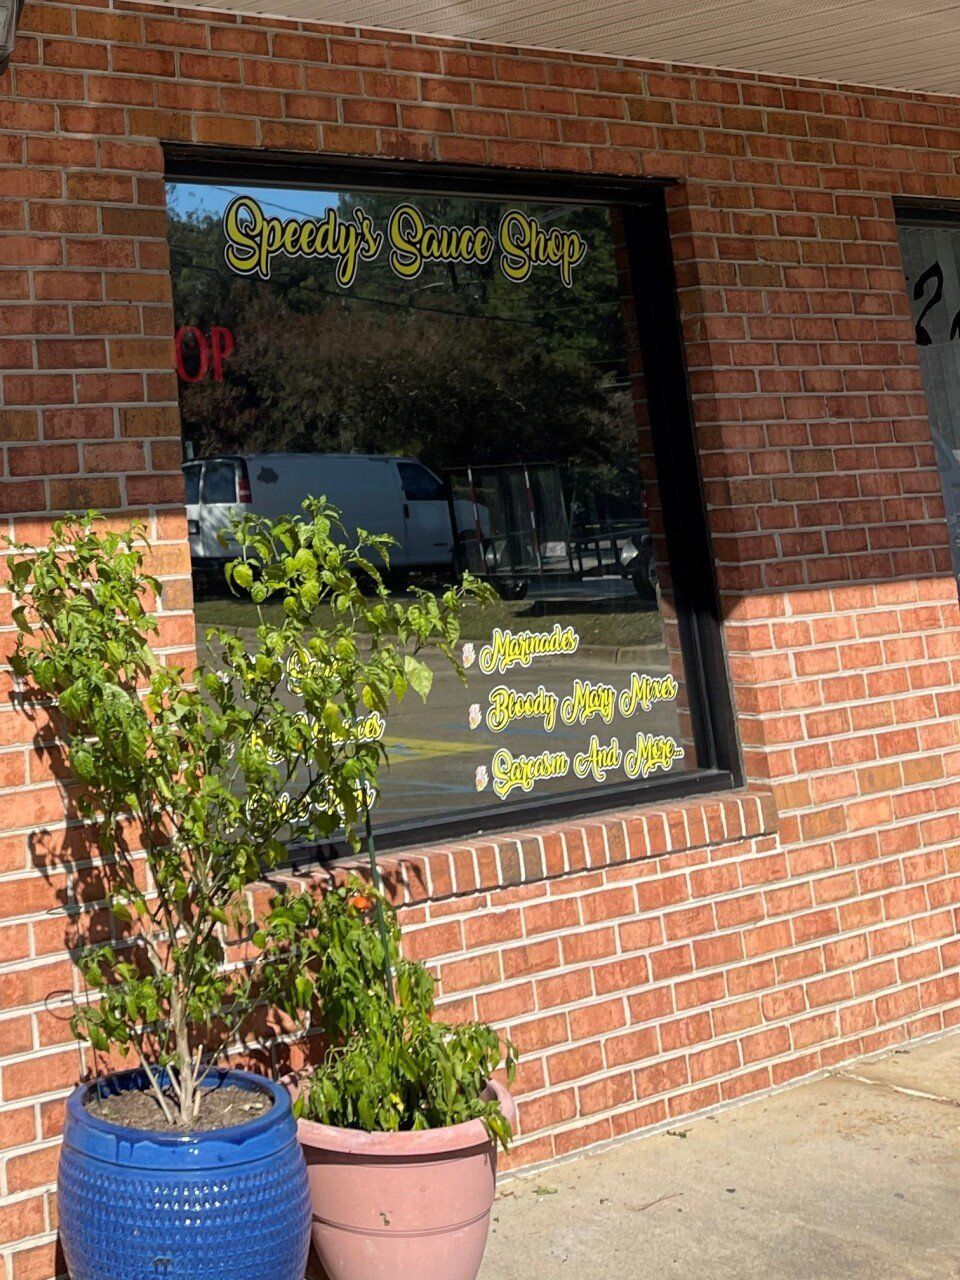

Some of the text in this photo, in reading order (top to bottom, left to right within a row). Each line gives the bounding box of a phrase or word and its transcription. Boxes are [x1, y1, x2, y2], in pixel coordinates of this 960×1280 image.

[224, 194, 587, 288] Speedy's Sauce Shop
[479, 623, 579, 674] Marinades
[486, 672, 678, 732] Bloody Mary Mixes
[492, 731, 684, 800] Sarcasm And More...
